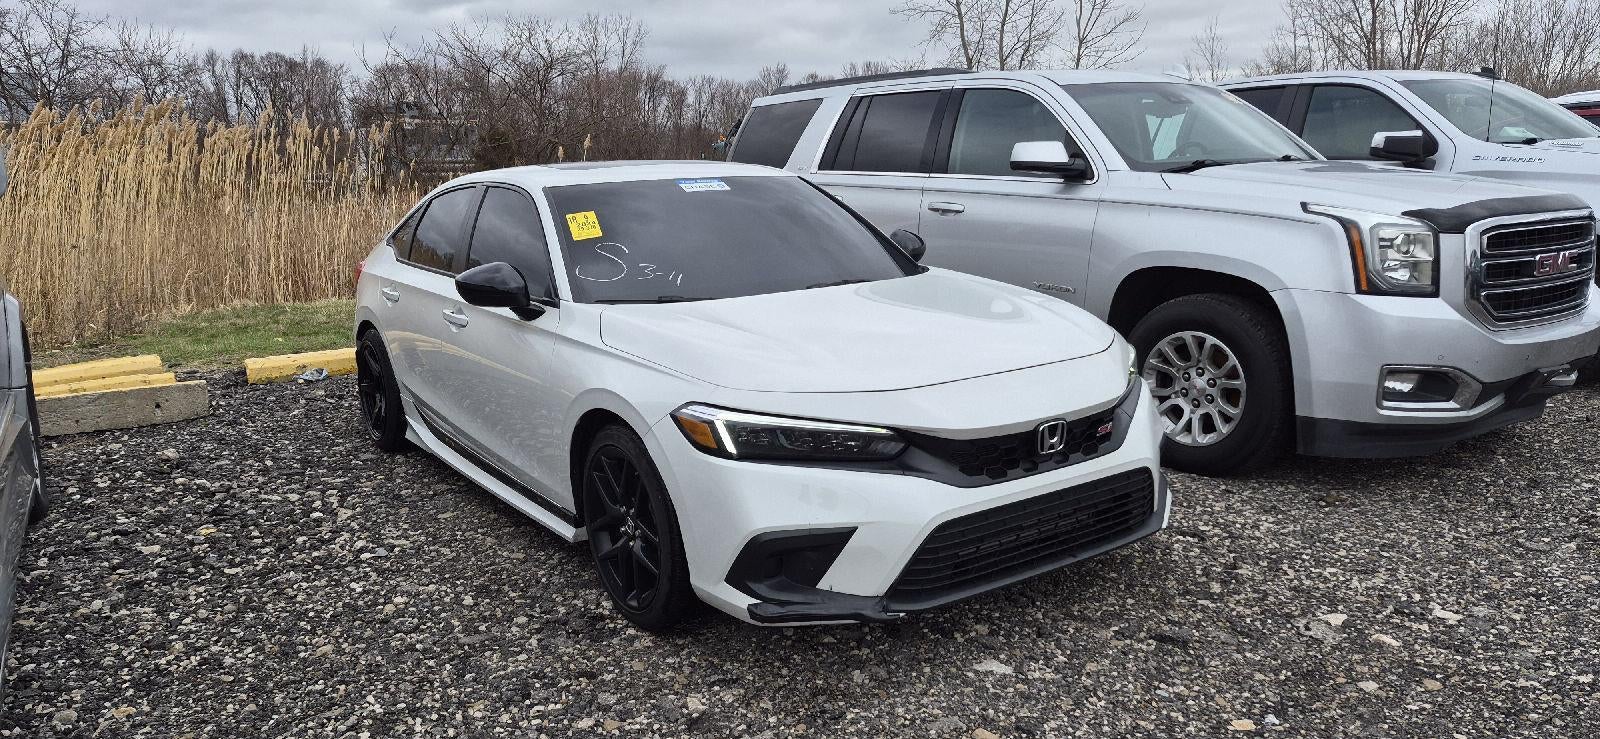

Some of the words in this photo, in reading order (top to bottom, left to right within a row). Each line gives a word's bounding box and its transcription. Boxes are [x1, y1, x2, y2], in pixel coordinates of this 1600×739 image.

[1472, 155, 1547, 163] SILVERADO
[576, 243, 628, 281] S
[1534, 250, 1578, 276] GMC
[1033, 281, 1076, 294] YUKON
